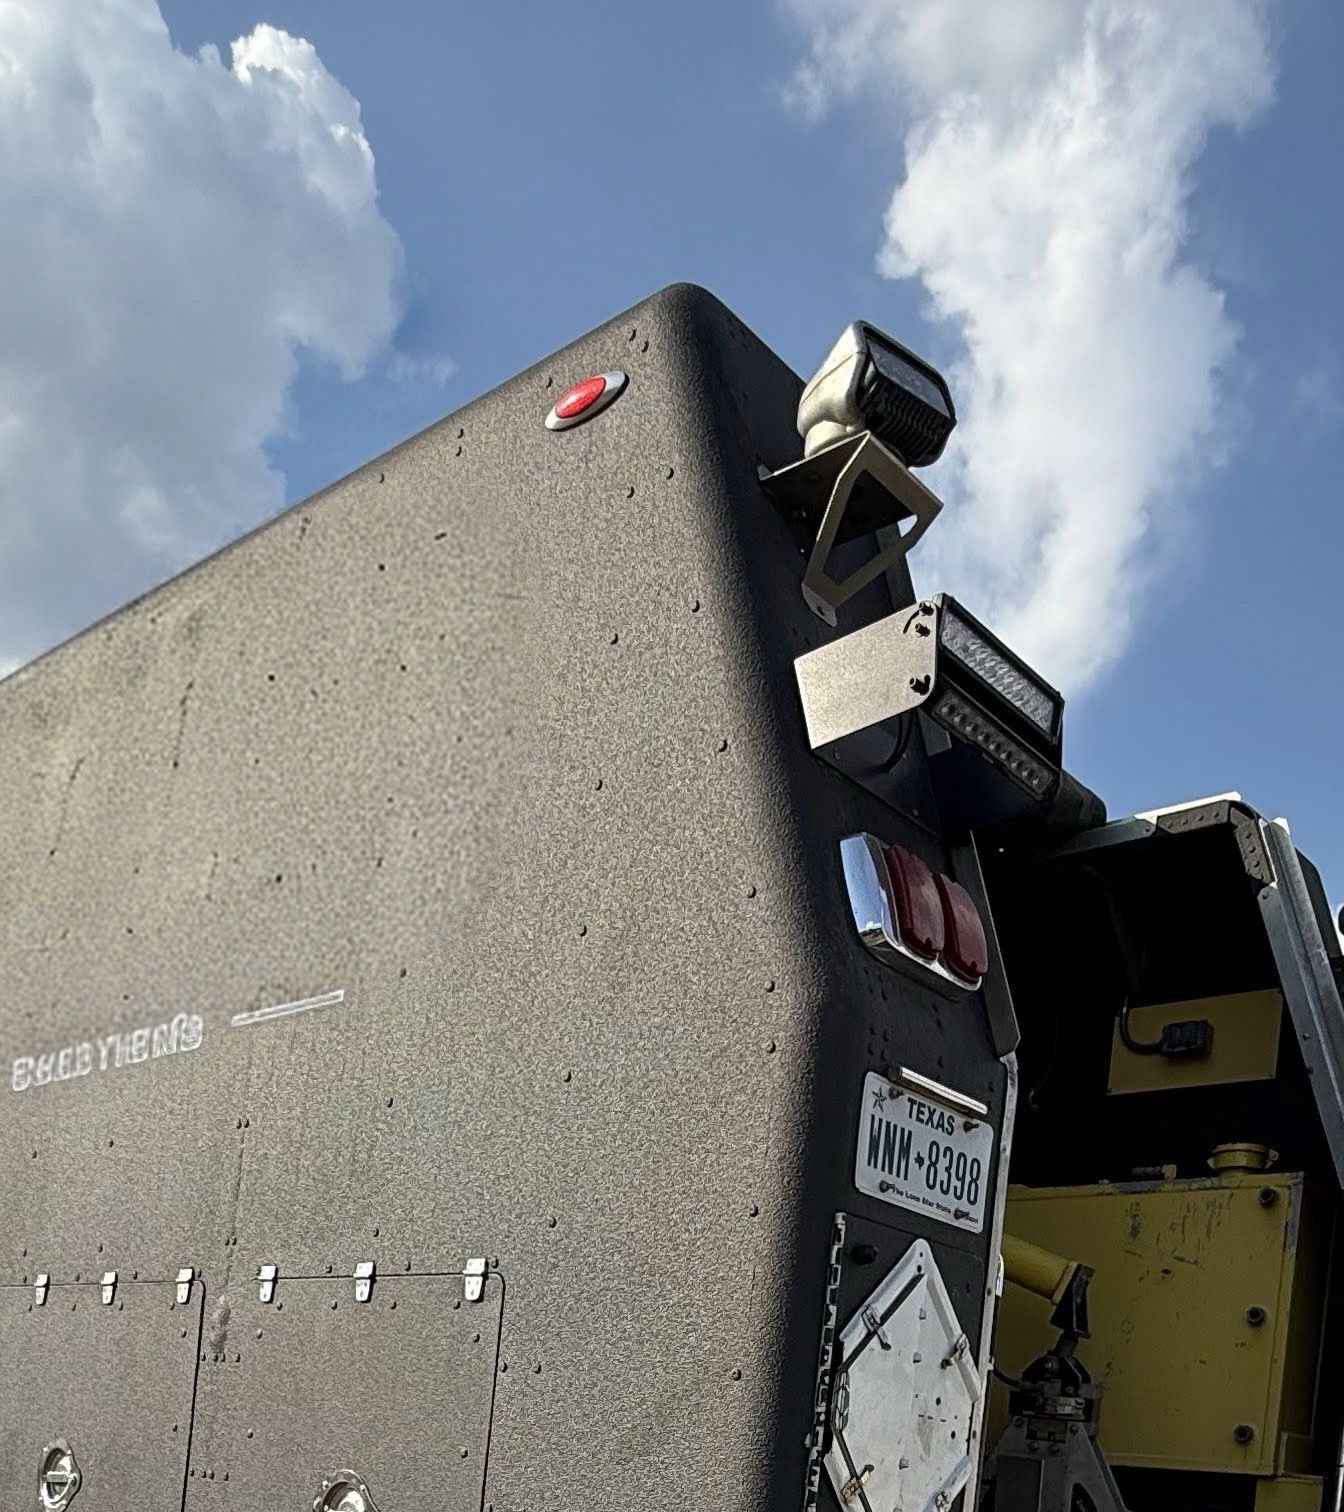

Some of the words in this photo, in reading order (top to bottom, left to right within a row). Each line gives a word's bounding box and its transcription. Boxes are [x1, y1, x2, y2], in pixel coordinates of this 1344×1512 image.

[907, 1097, 955, 1136] TEXAS
[867, 1114, 913, 1181] WNM
[925, 1140, 982, 1206] 8398
